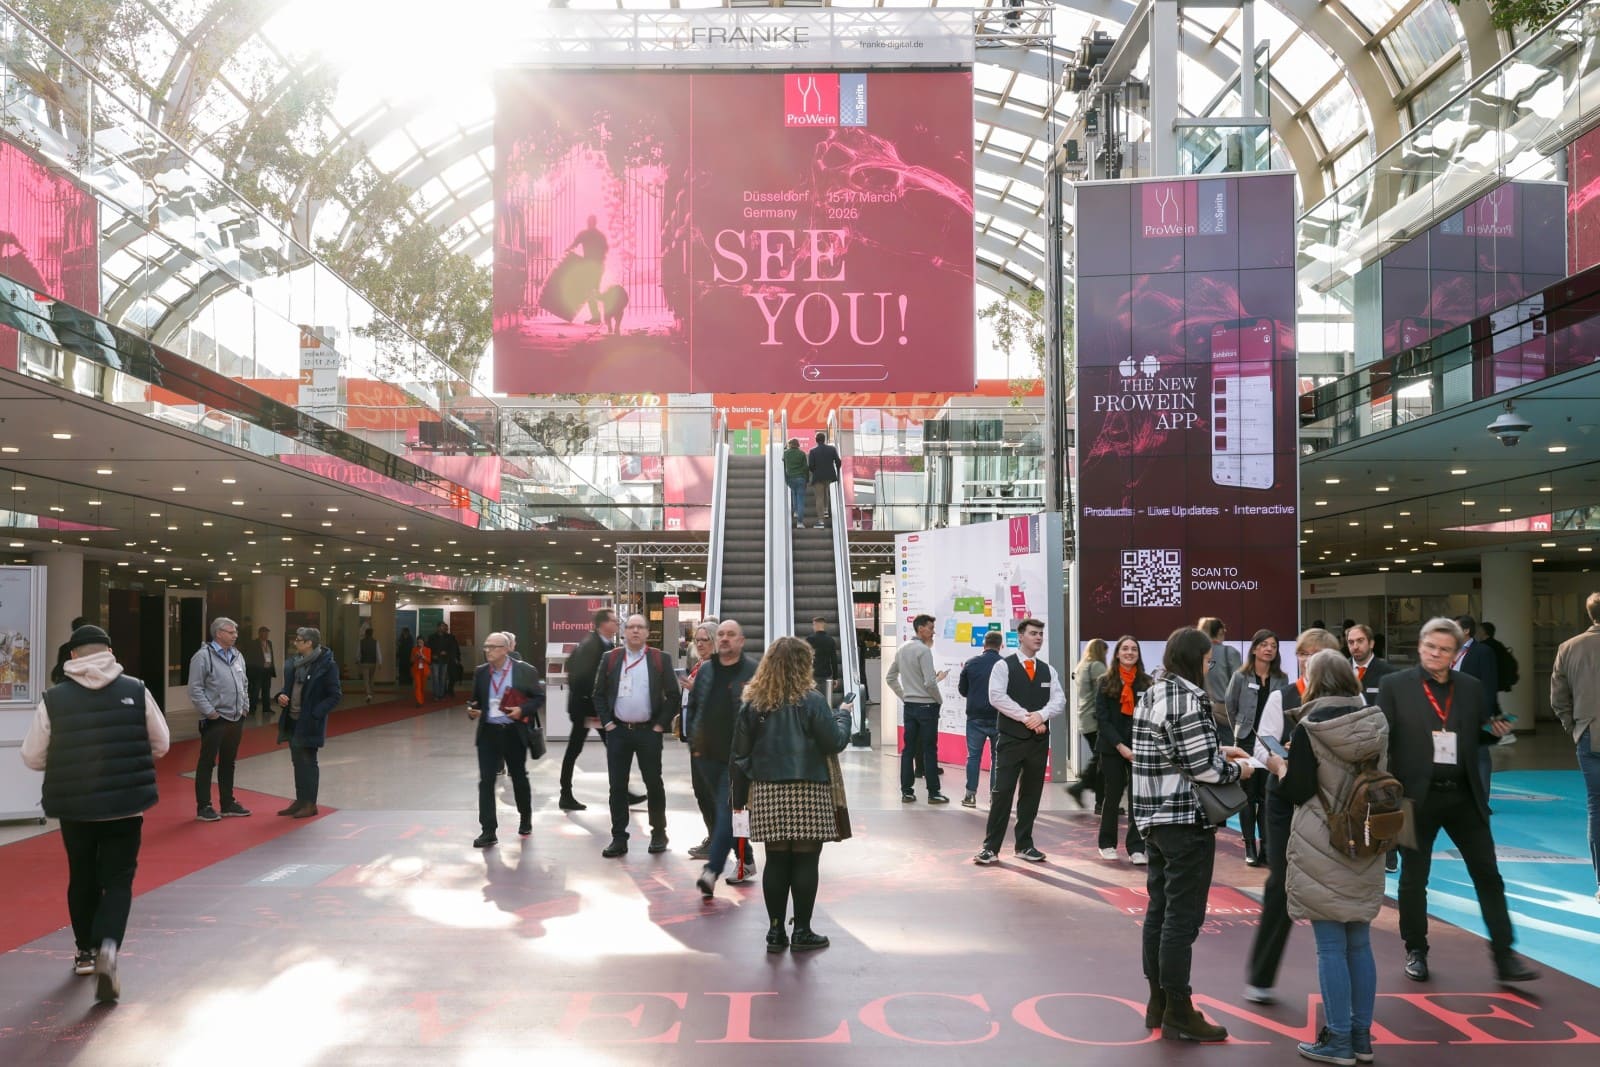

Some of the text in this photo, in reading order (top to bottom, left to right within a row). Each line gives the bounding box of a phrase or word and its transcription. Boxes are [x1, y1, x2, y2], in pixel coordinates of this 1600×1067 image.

[691, 26, 809, 43] FRANKE
[859, 40, 924, 50] franke-digital.de
[855, 84, 865, 124] ProSpirits
[786, 113, 836, 125] ProWein
[743, 190, 809, 202] Düsseldorf
[859, 191, 897, 203] March
[743, 207, 798, 219] Germany
[828, 208, 858, 219] 2026
[1214, 192, 1224, 232] ProSpirits
[1145, 224, 1195, 236] ProWein
[713, 229, 846, 283] SEE
[749, 291, 908, 346] YOU!
[1121, 377, 1197, 392] THE NEW
[1094, 393, 1196, 412] PROWEIN
[731, 405, 765, 413] business.
[1155, 412, 1198, 430] APP
[1148, 506, 1170, 516] Live
[1172, 505, 1219, 517] Updates
[1235, 504, 1295, 515] Interactive
[1191, 568, 1238, 577] SCAN TO
[1191, 580, 1258, 590] DOWNLOAD!
